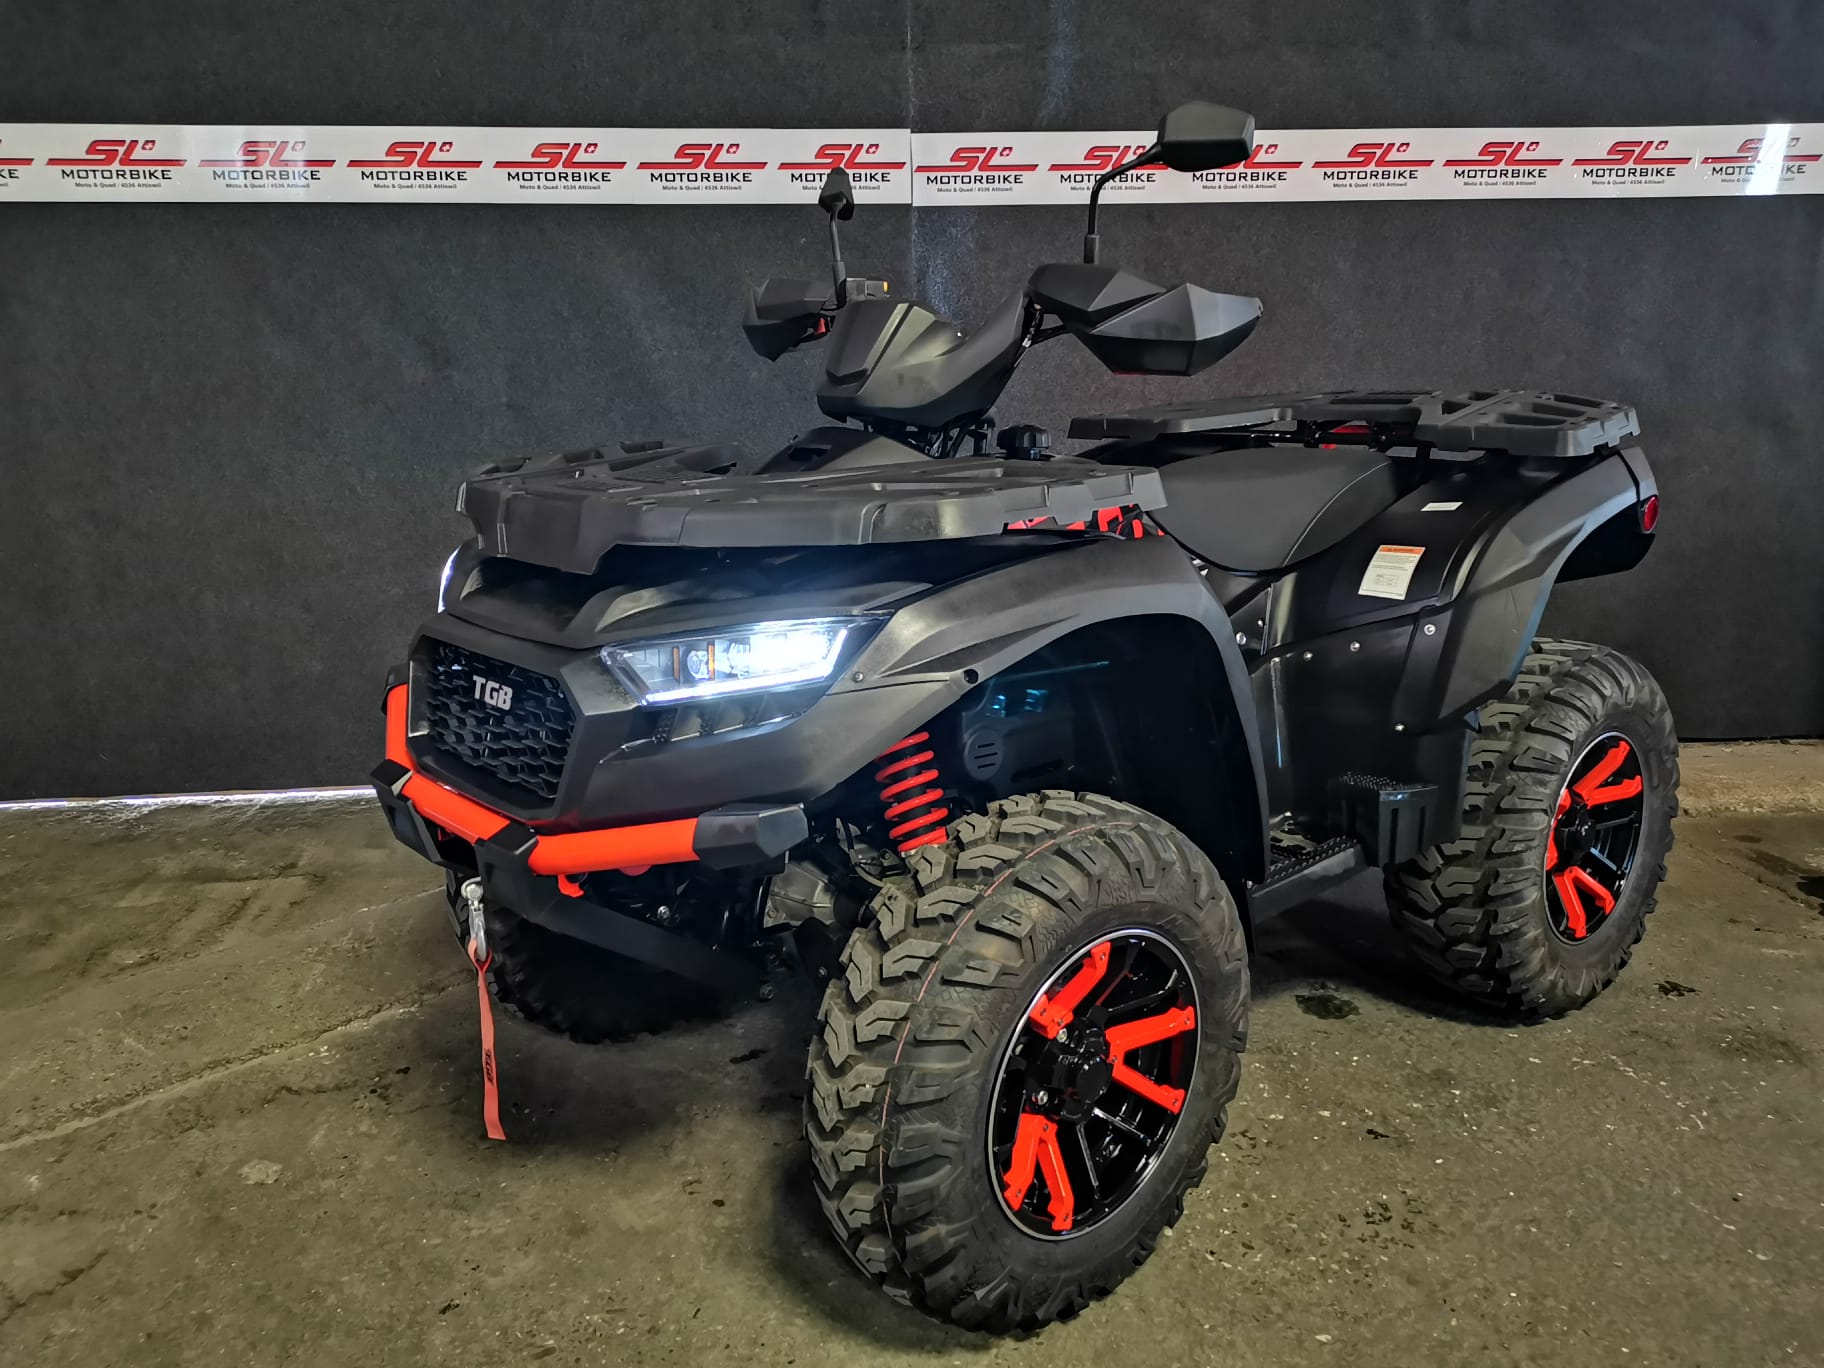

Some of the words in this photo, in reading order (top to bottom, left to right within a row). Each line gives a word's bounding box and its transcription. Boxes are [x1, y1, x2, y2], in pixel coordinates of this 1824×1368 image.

[61, 169, 172, 179] MOTORBIKE
[213, 170, 321, 180] MOTORBIKE
[361, 171, 468, 181] MOTORBIKE
[507, 172, 612, 182] MOTORBIKE
[650, 172, 753, 182] MOTORBIKE
[791, 172, 891, 182] MOTBIKE
[1192, 171, 1288, 182] MOTORBIKE
[1323, 170, 1418, 180] MOTORBIKE
[1454, 169, 1547, 179] MOTORBIKE
[1582, 167, 1676, 178] MOTORBIKE
[926, 174, 1024, 185] MOTORBIKE
[472, 674, 513, 711] TGB
